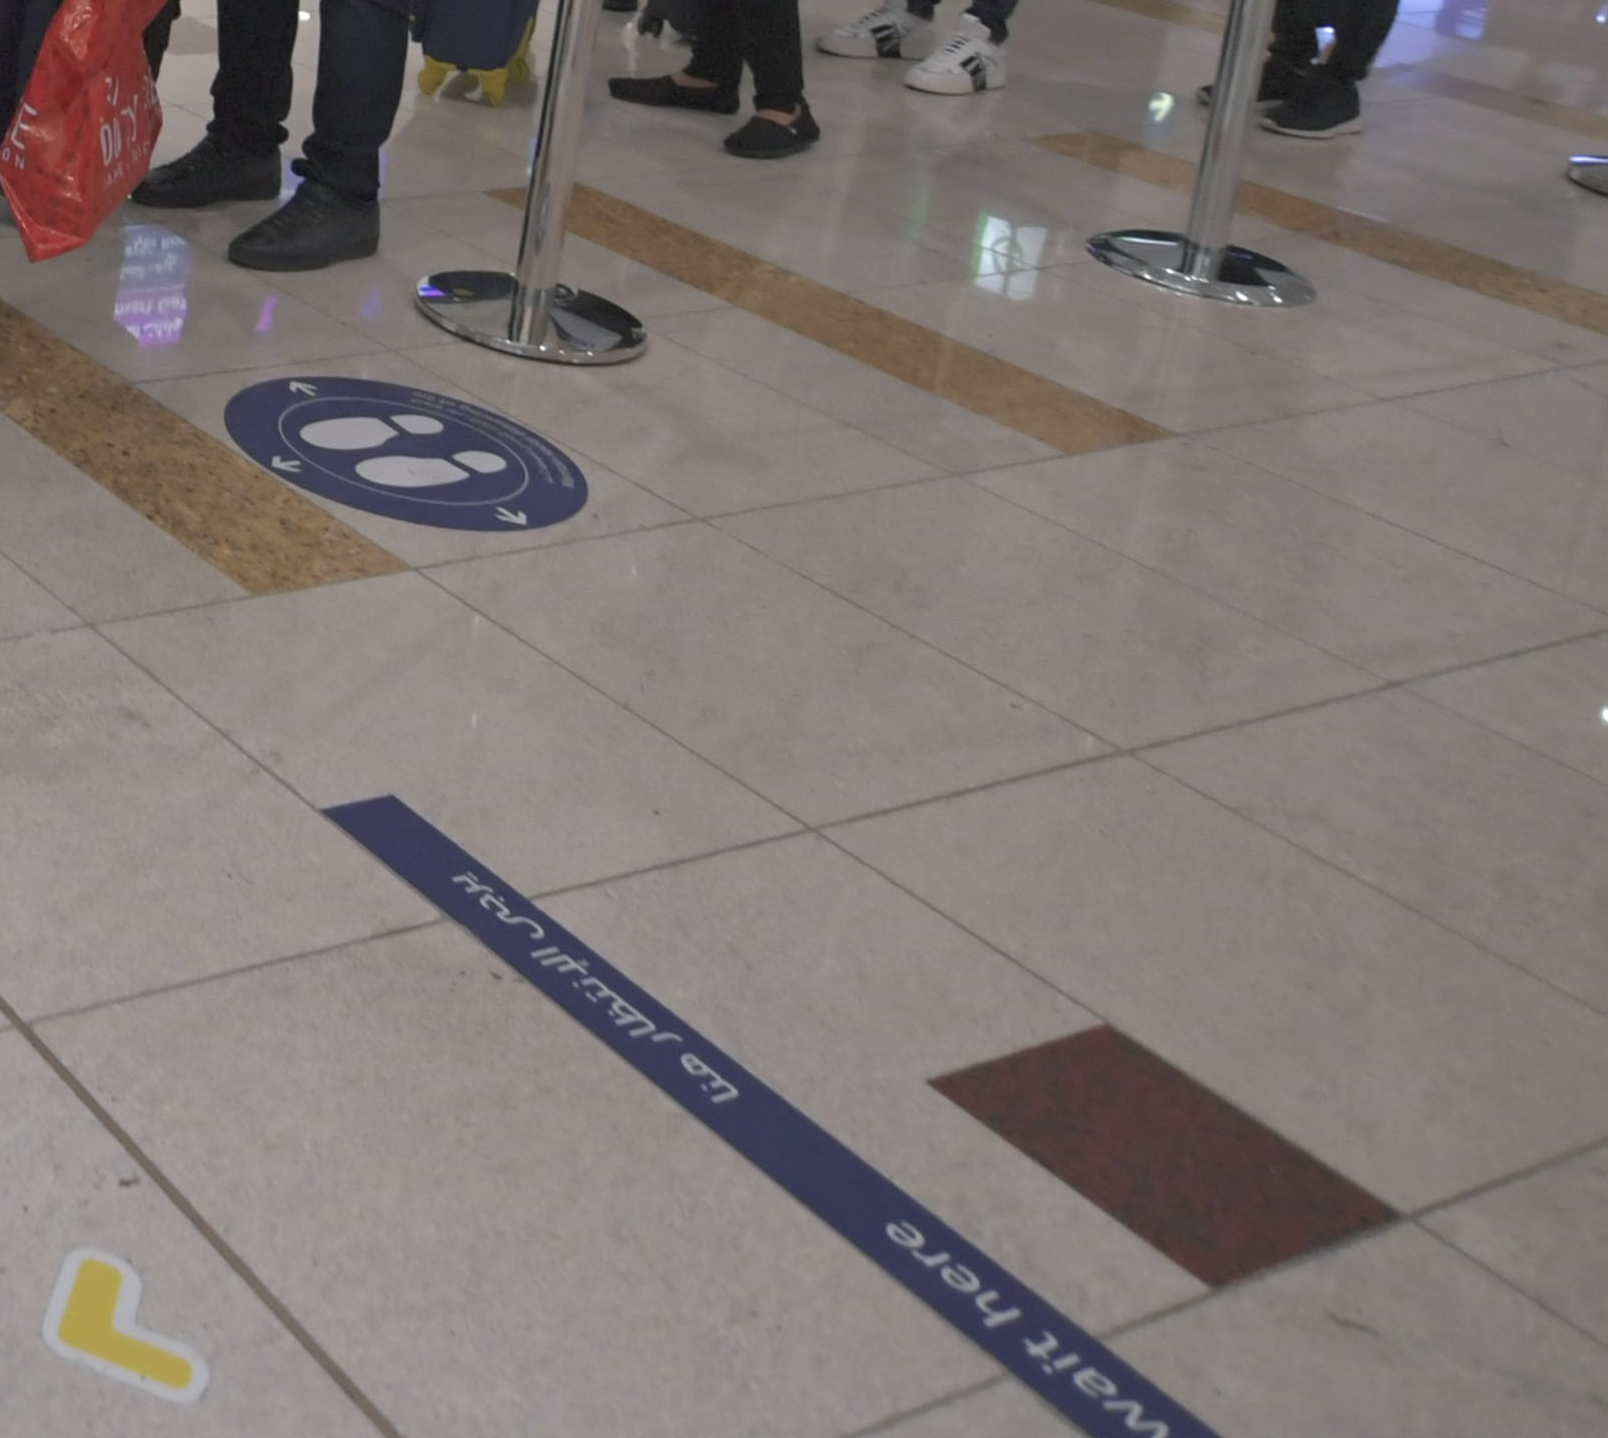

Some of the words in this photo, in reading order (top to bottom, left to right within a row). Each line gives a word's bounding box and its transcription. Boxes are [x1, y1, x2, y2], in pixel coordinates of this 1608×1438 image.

[452, 871, 545, 939] يرجى
[680, 1053, 740, 1104] هنا
[885, 1220, 1021, 1328] here
[1023, 1330, 1170, 1438] wait
